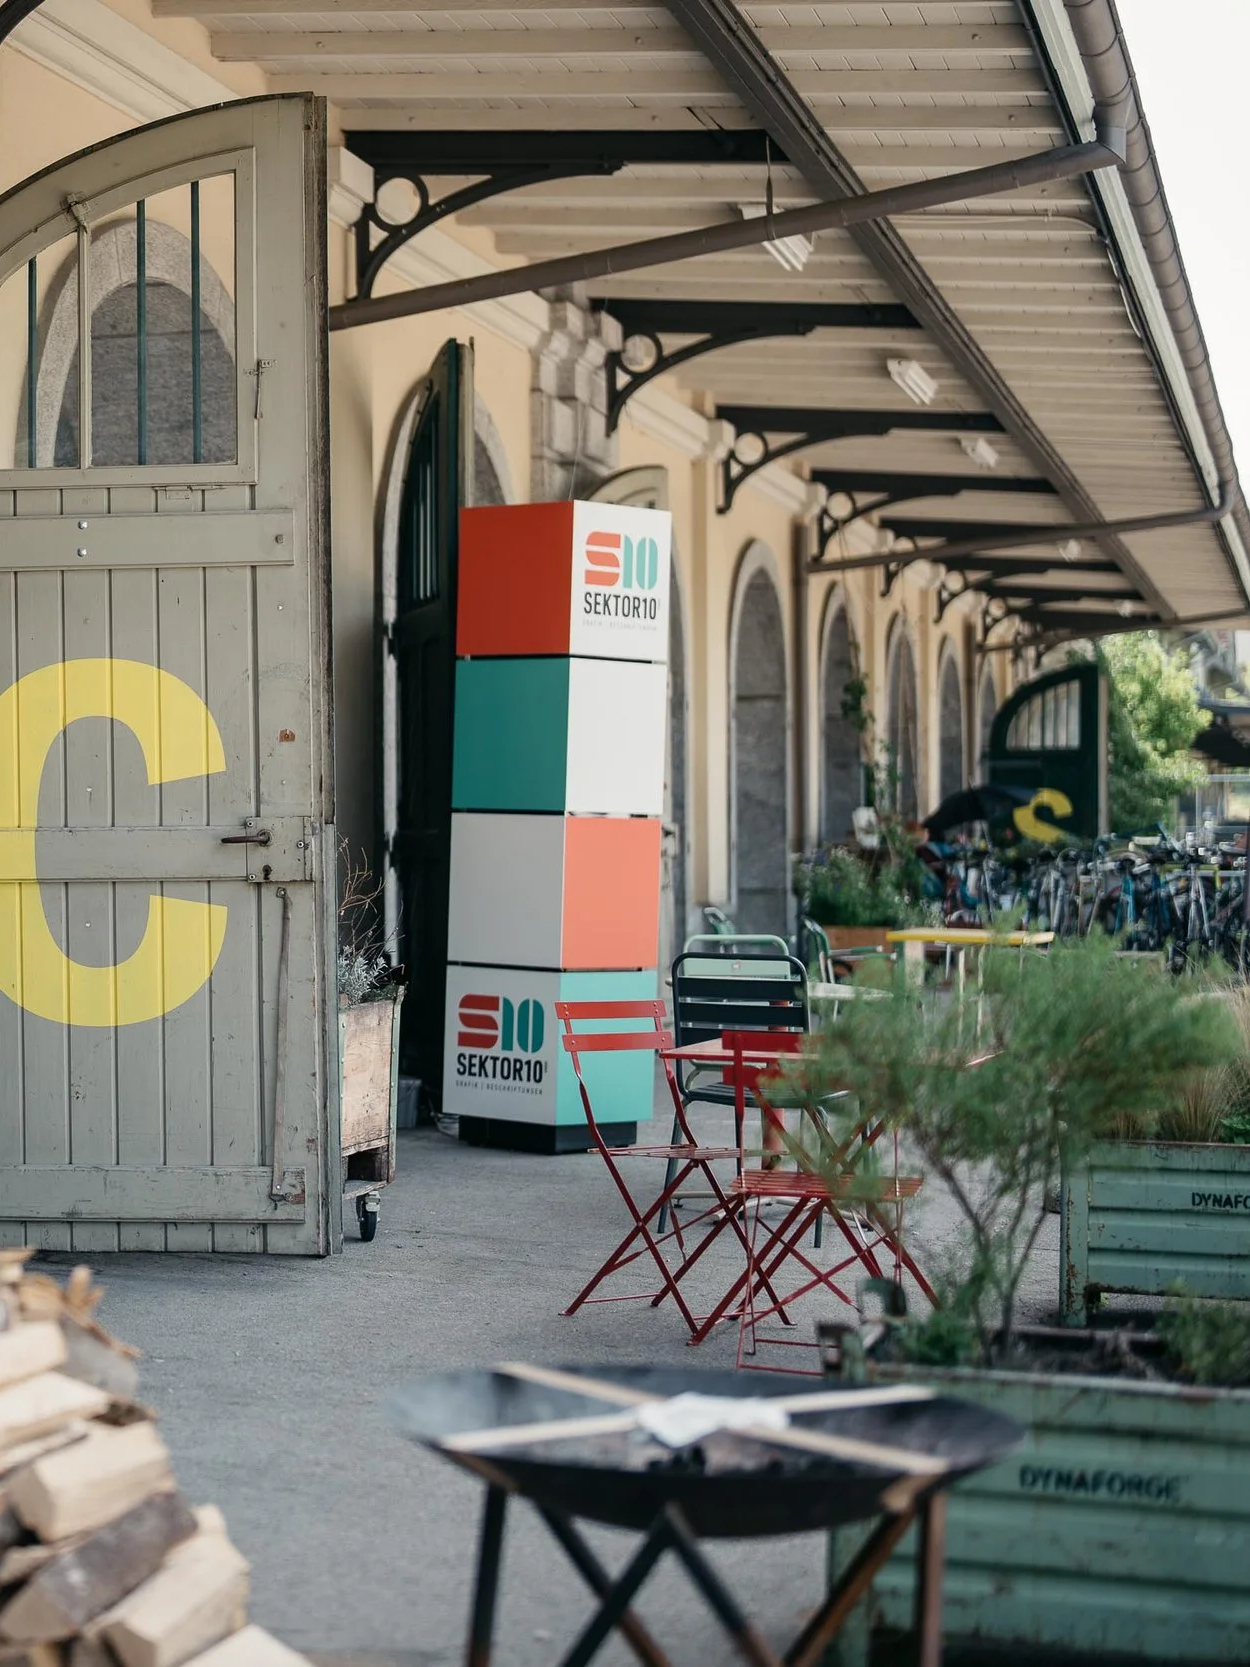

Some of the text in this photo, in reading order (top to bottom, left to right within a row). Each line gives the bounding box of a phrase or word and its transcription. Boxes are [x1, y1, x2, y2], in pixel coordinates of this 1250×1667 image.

[584, 531, 659, 590] S10
[584, 592, 658, 620] SEKTOR10
[457, 993, 545, 1053] S10
[456, 1053, 543, 1083] SEKTOR10
